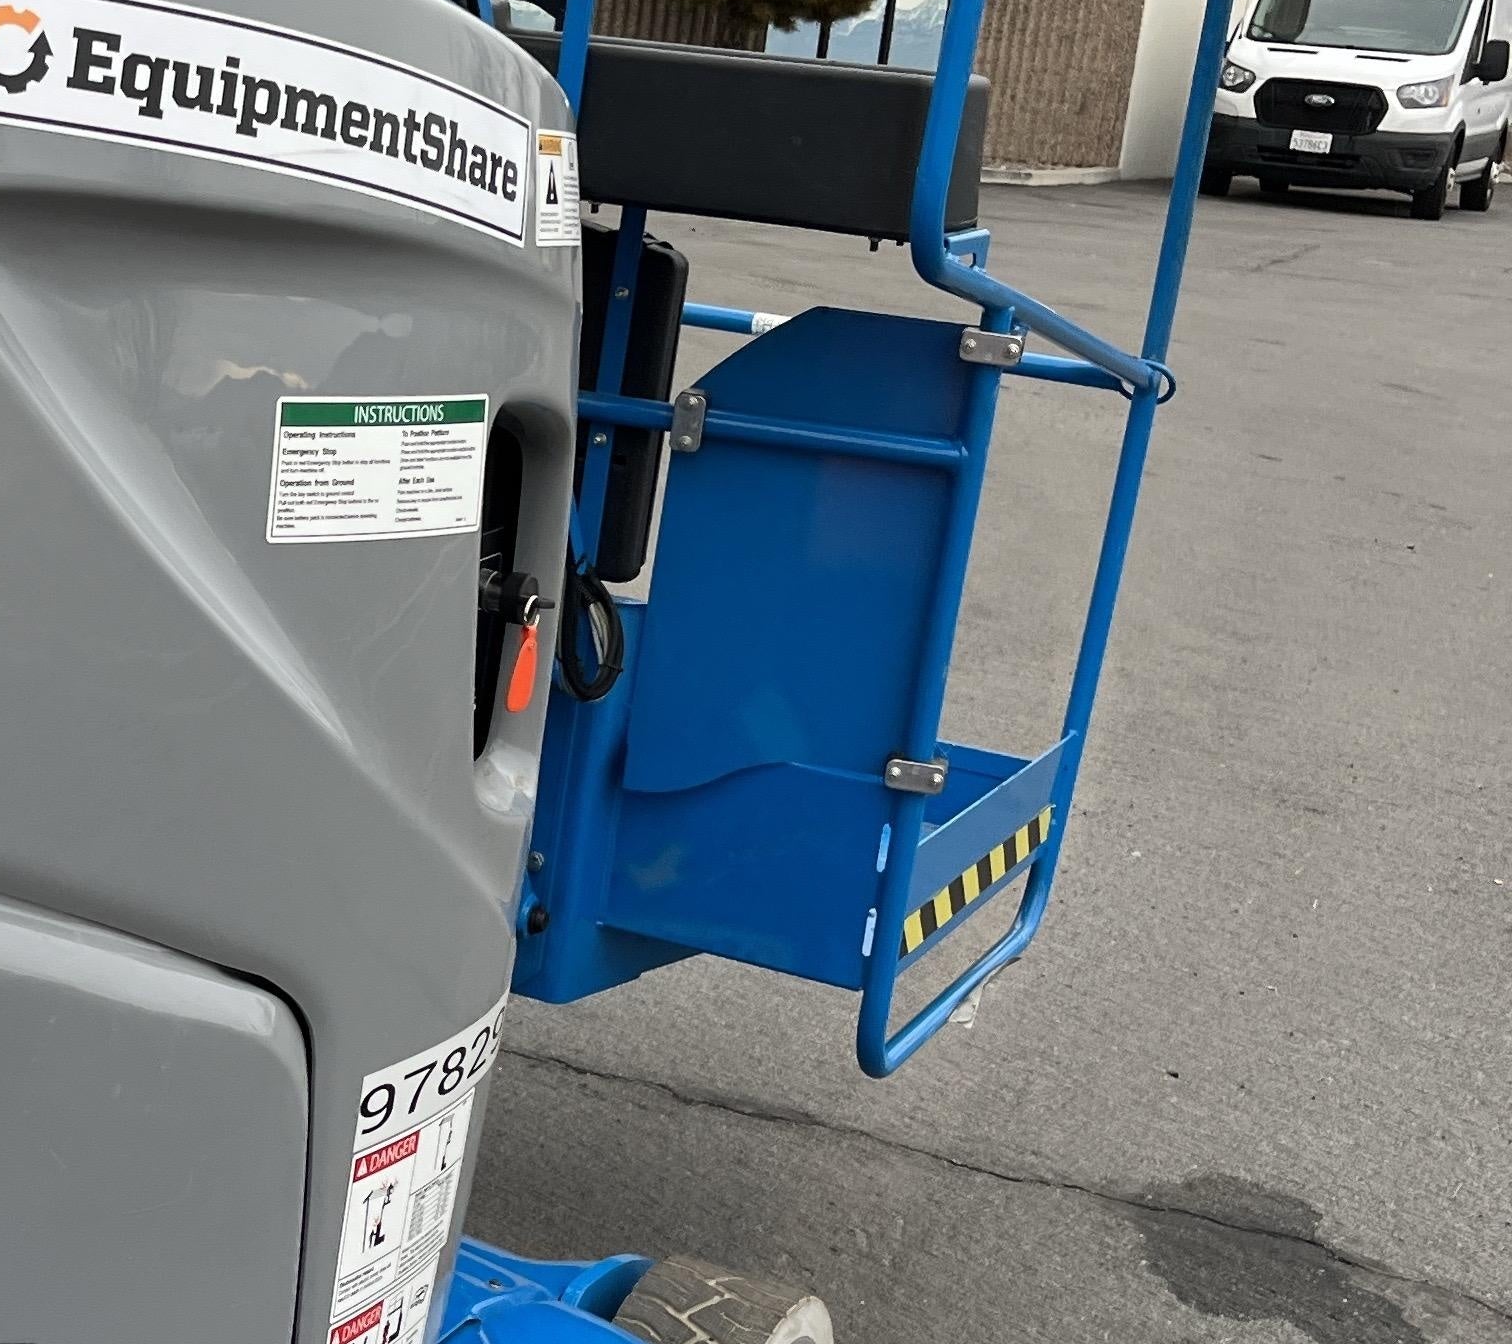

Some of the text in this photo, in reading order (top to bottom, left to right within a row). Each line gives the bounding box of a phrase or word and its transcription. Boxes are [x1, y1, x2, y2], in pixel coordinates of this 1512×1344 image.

[65, 26, 519, 204] EquipmentShare
[354, 404, 444, 423] INSTRUCTIONS
[369, 1135, 417, 1172] DANGER
[341, 1307, 382, 1343] DANGER
